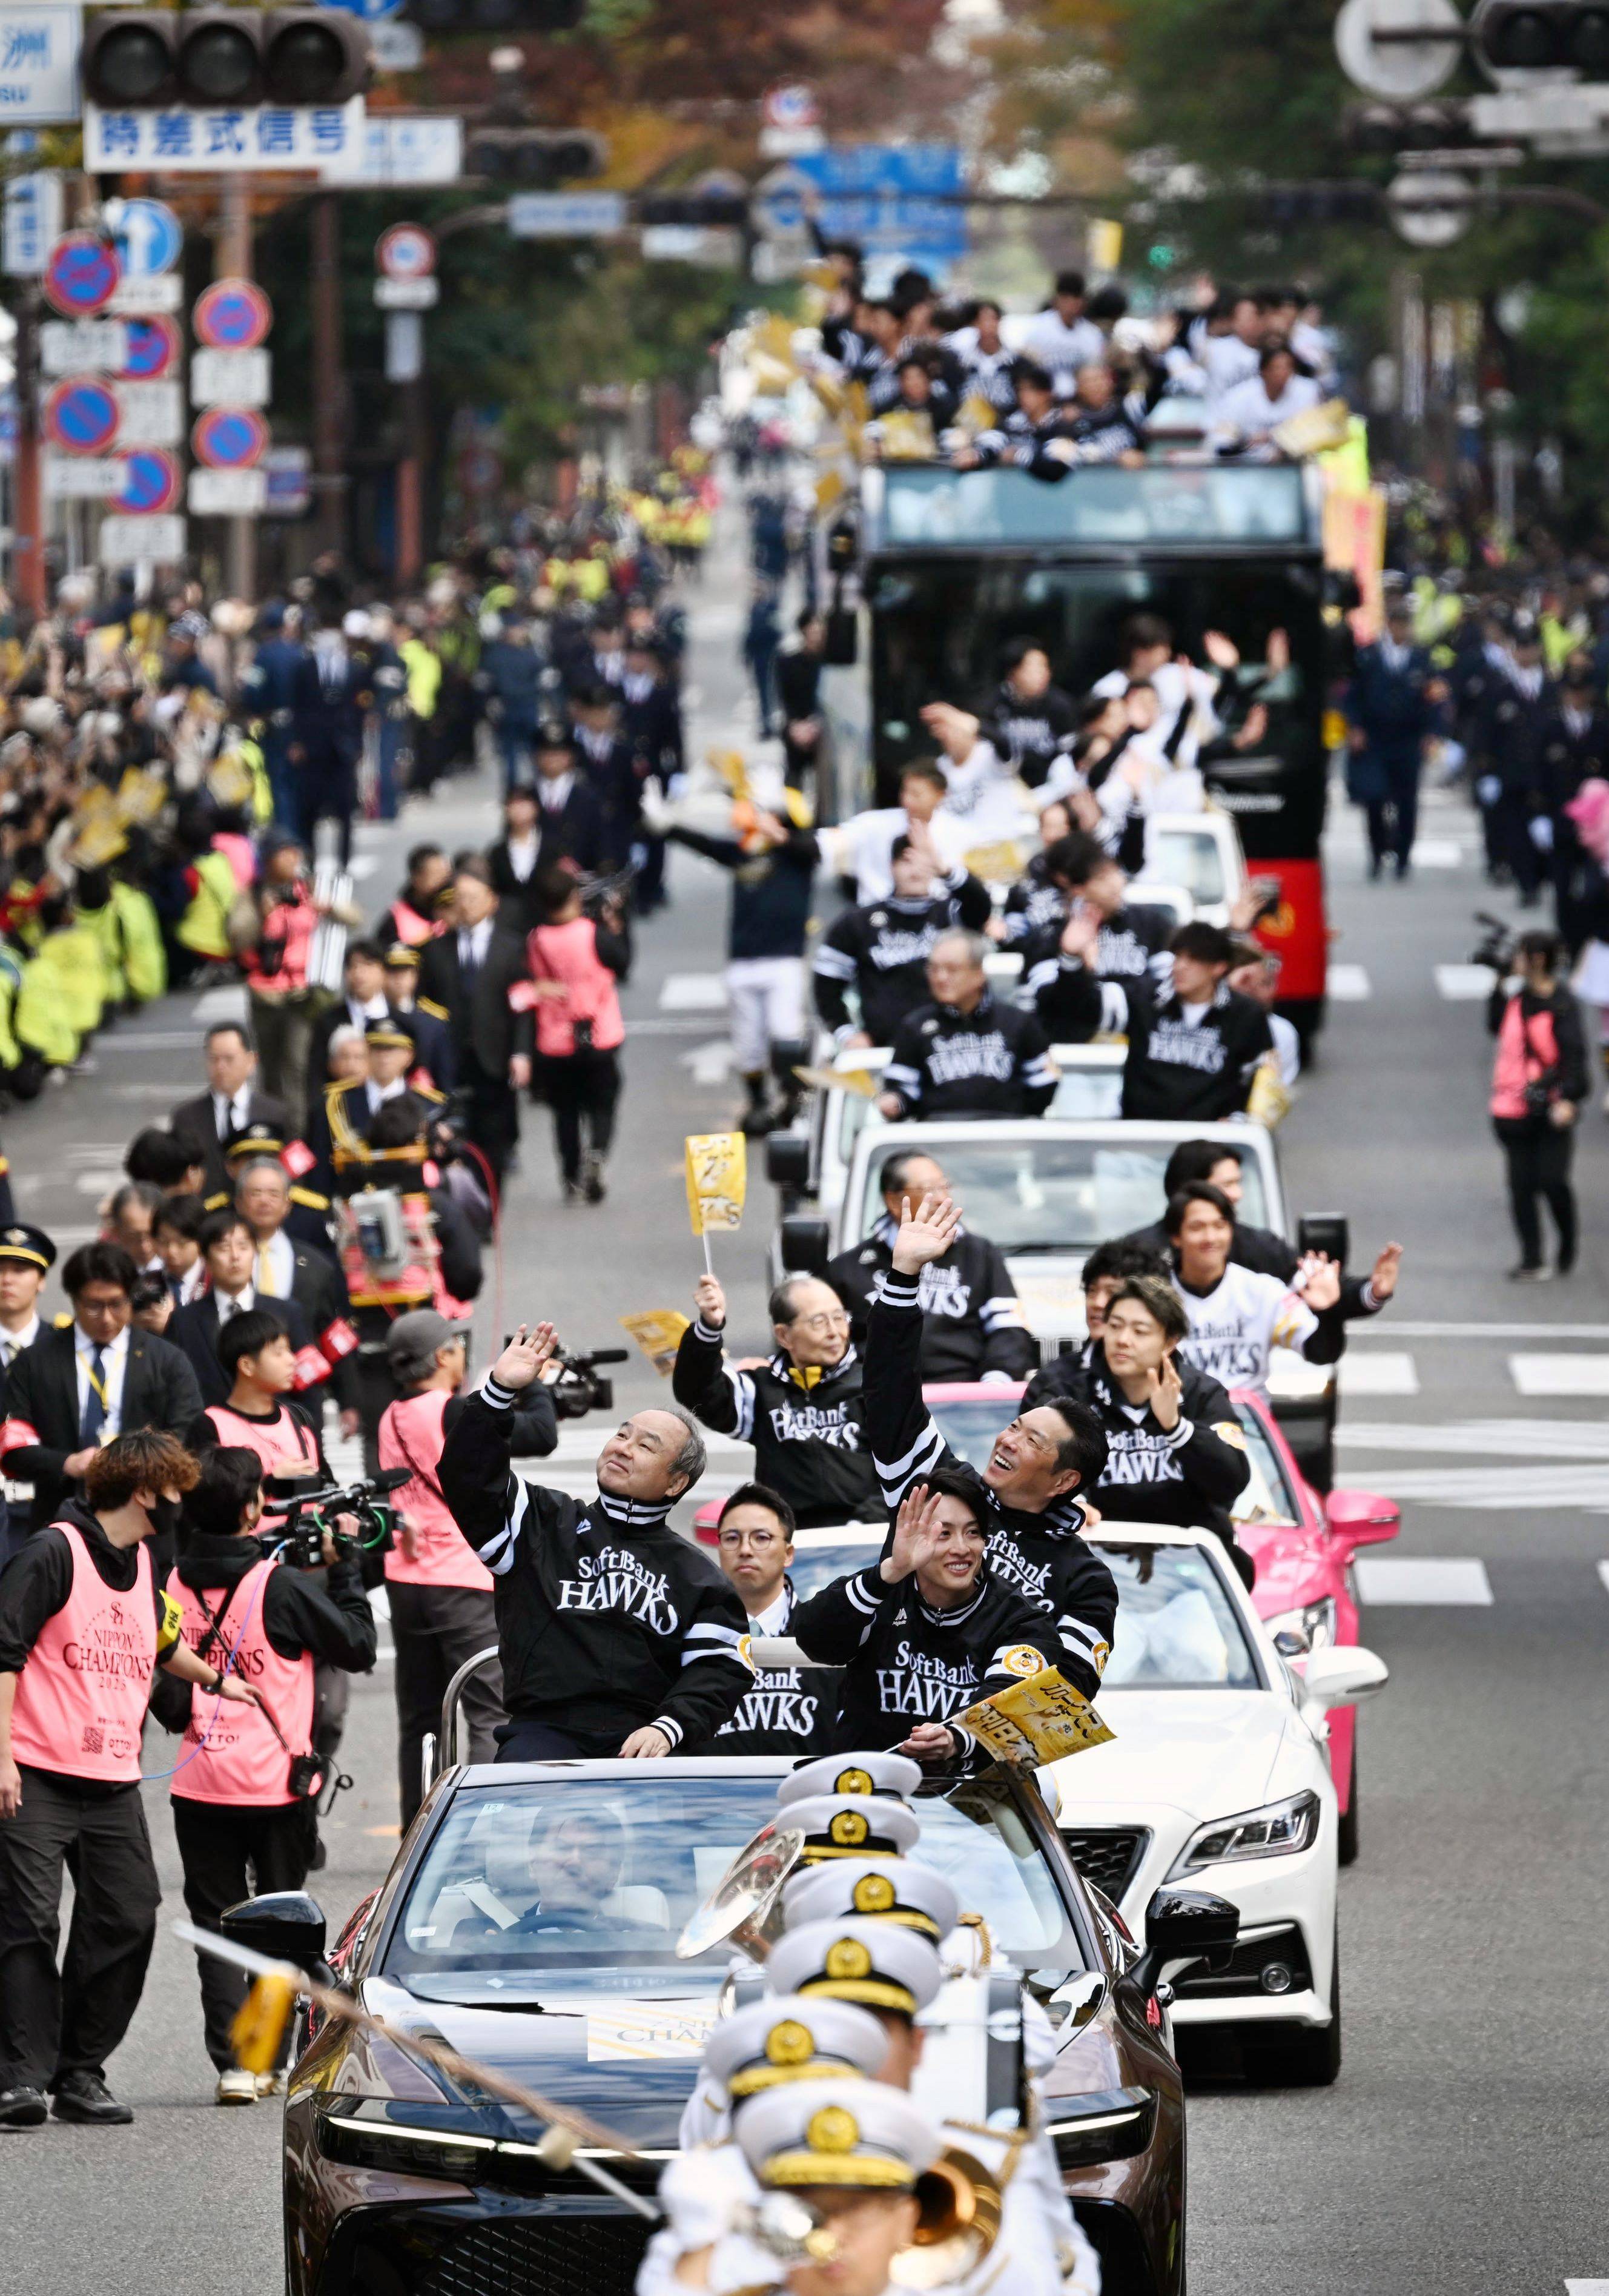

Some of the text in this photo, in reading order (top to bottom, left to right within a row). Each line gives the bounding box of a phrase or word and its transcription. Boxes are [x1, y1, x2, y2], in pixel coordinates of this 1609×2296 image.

[101, 110, 343, 155] 時差式信号
[578, 1546, 670, 1602] SoftBank
[557, 1571, 678, 1635] HAWKS
[62, 1642, 153, 1681] CHAMPIONS
[94, 1629, 136, 1651] NIPPON
[895, 1640, 980, 1686] SoftBank
[714, 1692, 818, 1737] AWKS
